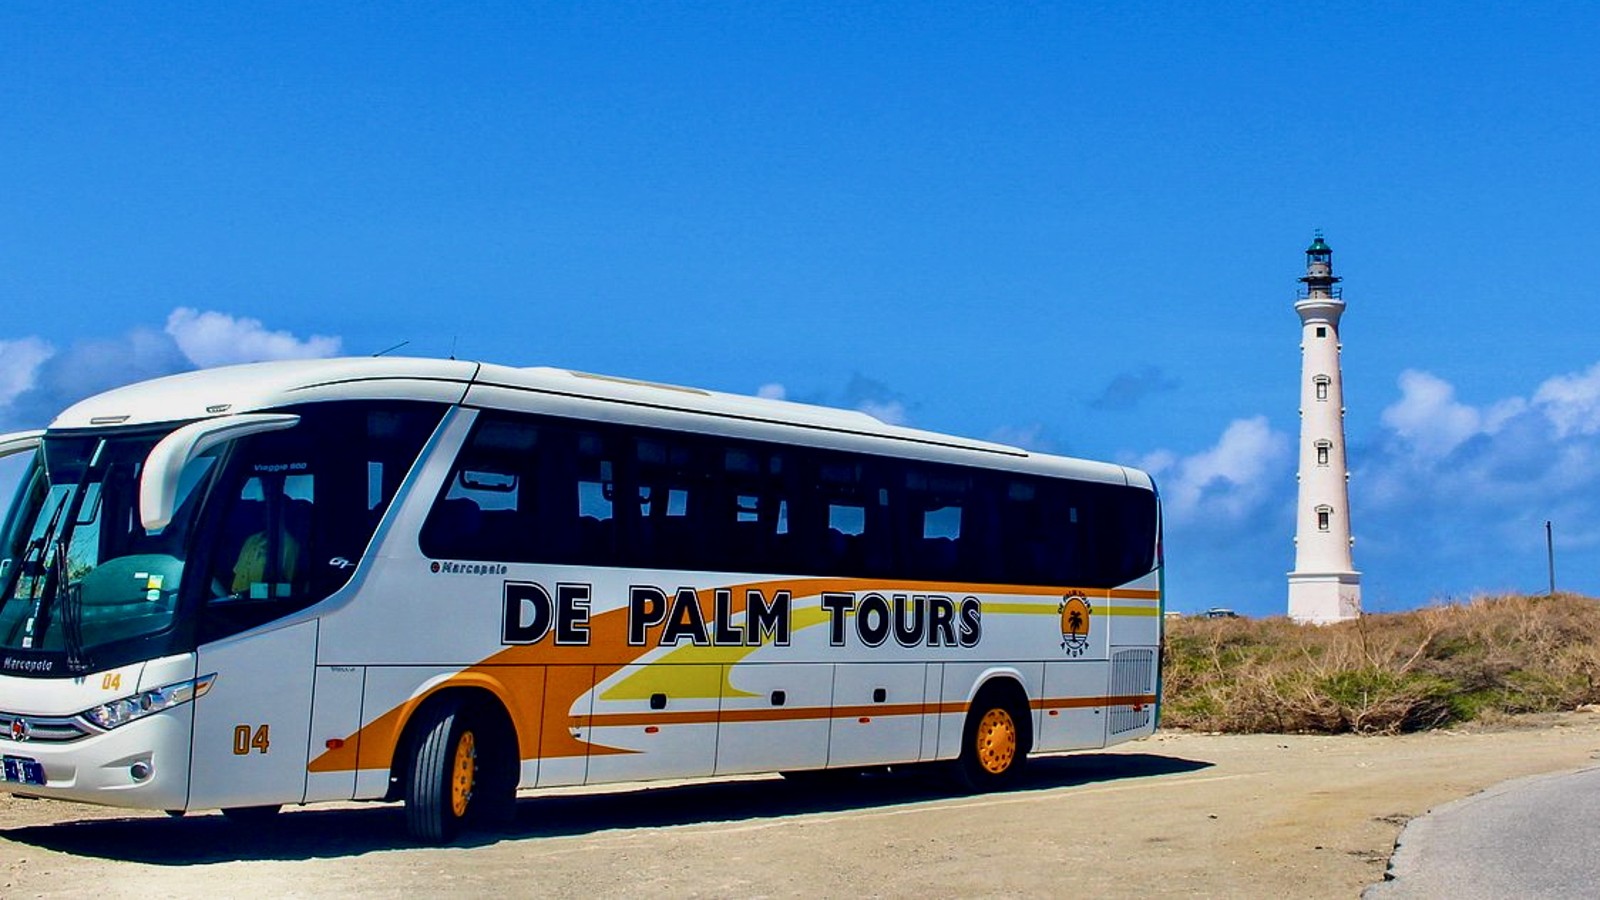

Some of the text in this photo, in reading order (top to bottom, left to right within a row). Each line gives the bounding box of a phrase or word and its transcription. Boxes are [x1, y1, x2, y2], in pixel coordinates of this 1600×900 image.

[442, 561, 508, 575] Marcopolo
[501, 579, 982, 649] DE PALM TOURS
[3, 656, 53, 672] Marcopolo
[102, 673, 122, 690] 04
[233, 724, 270, 756] 04
